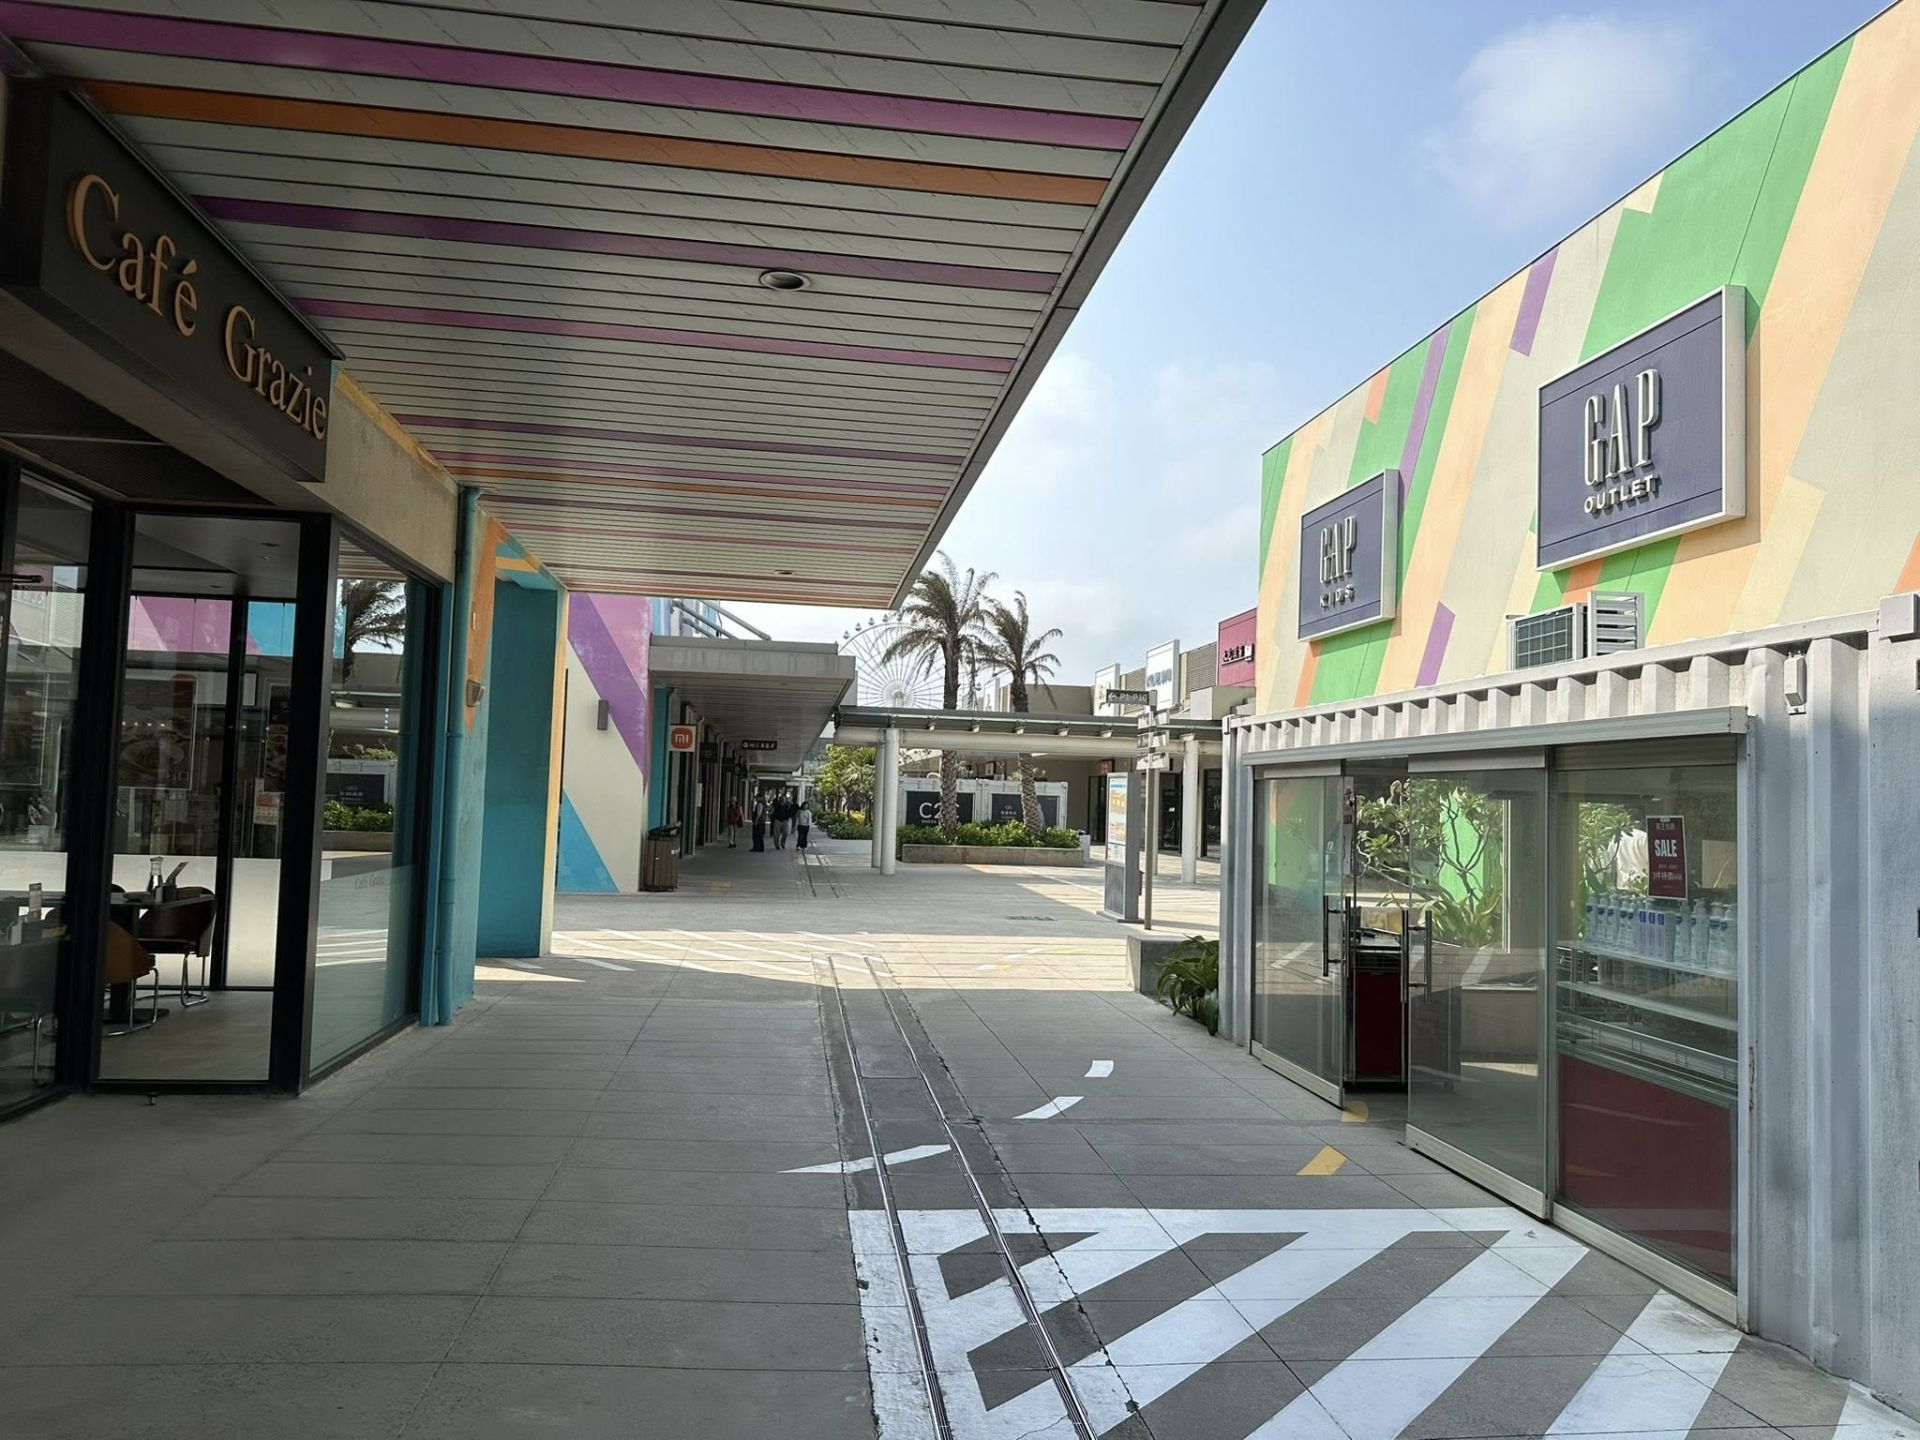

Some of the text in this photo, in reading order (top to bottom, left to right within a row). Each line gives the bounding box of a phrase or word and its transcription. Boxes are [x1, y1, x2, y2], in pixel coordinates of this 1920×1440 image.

[67, 174, 326, 440] Café Grazie
[1584, 369, 1659, 487] GAP
[1584, 474, 1660, 514] OUTLET
[1319, 516, 1357, 583] GAP
[1320, 584, 1355, 609] KIDS
[1654, 839, 1678, 857] SALE
